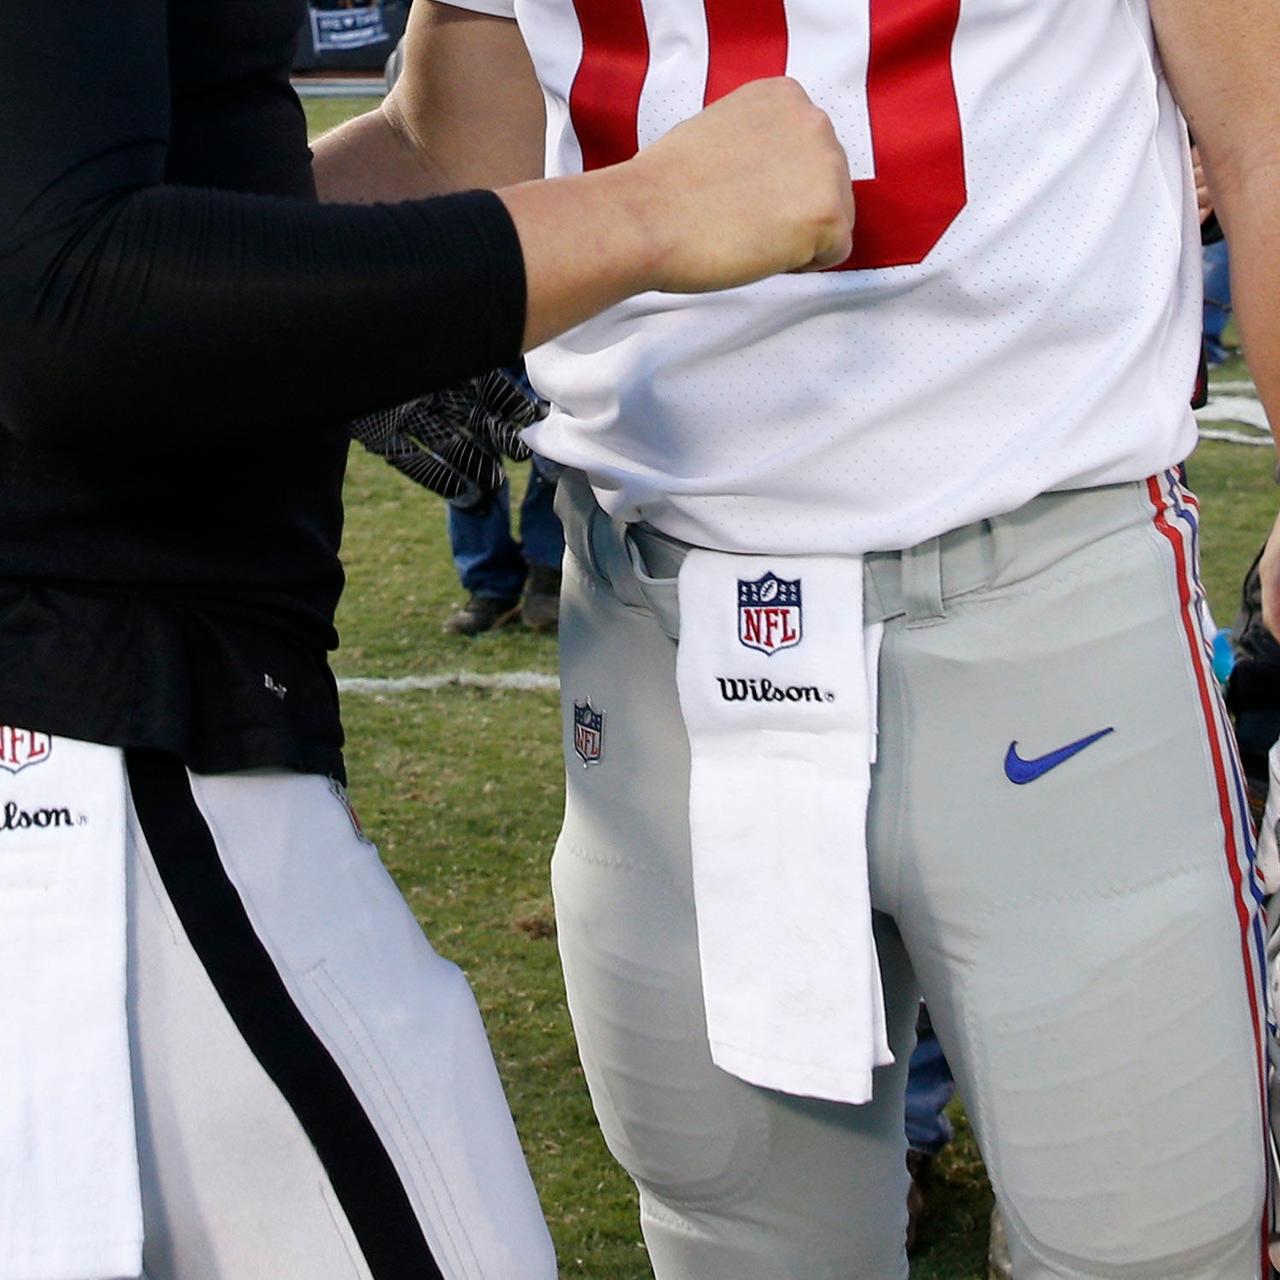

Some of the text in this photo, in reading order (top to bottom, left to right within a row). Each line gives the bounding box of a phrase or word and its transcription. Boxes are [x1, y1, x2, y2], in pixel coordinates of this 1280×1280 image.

[743, 606, 797, 649] NFL
[716, 676, 824, 703] Wilson
[576, 725, 601, 755] NFL
